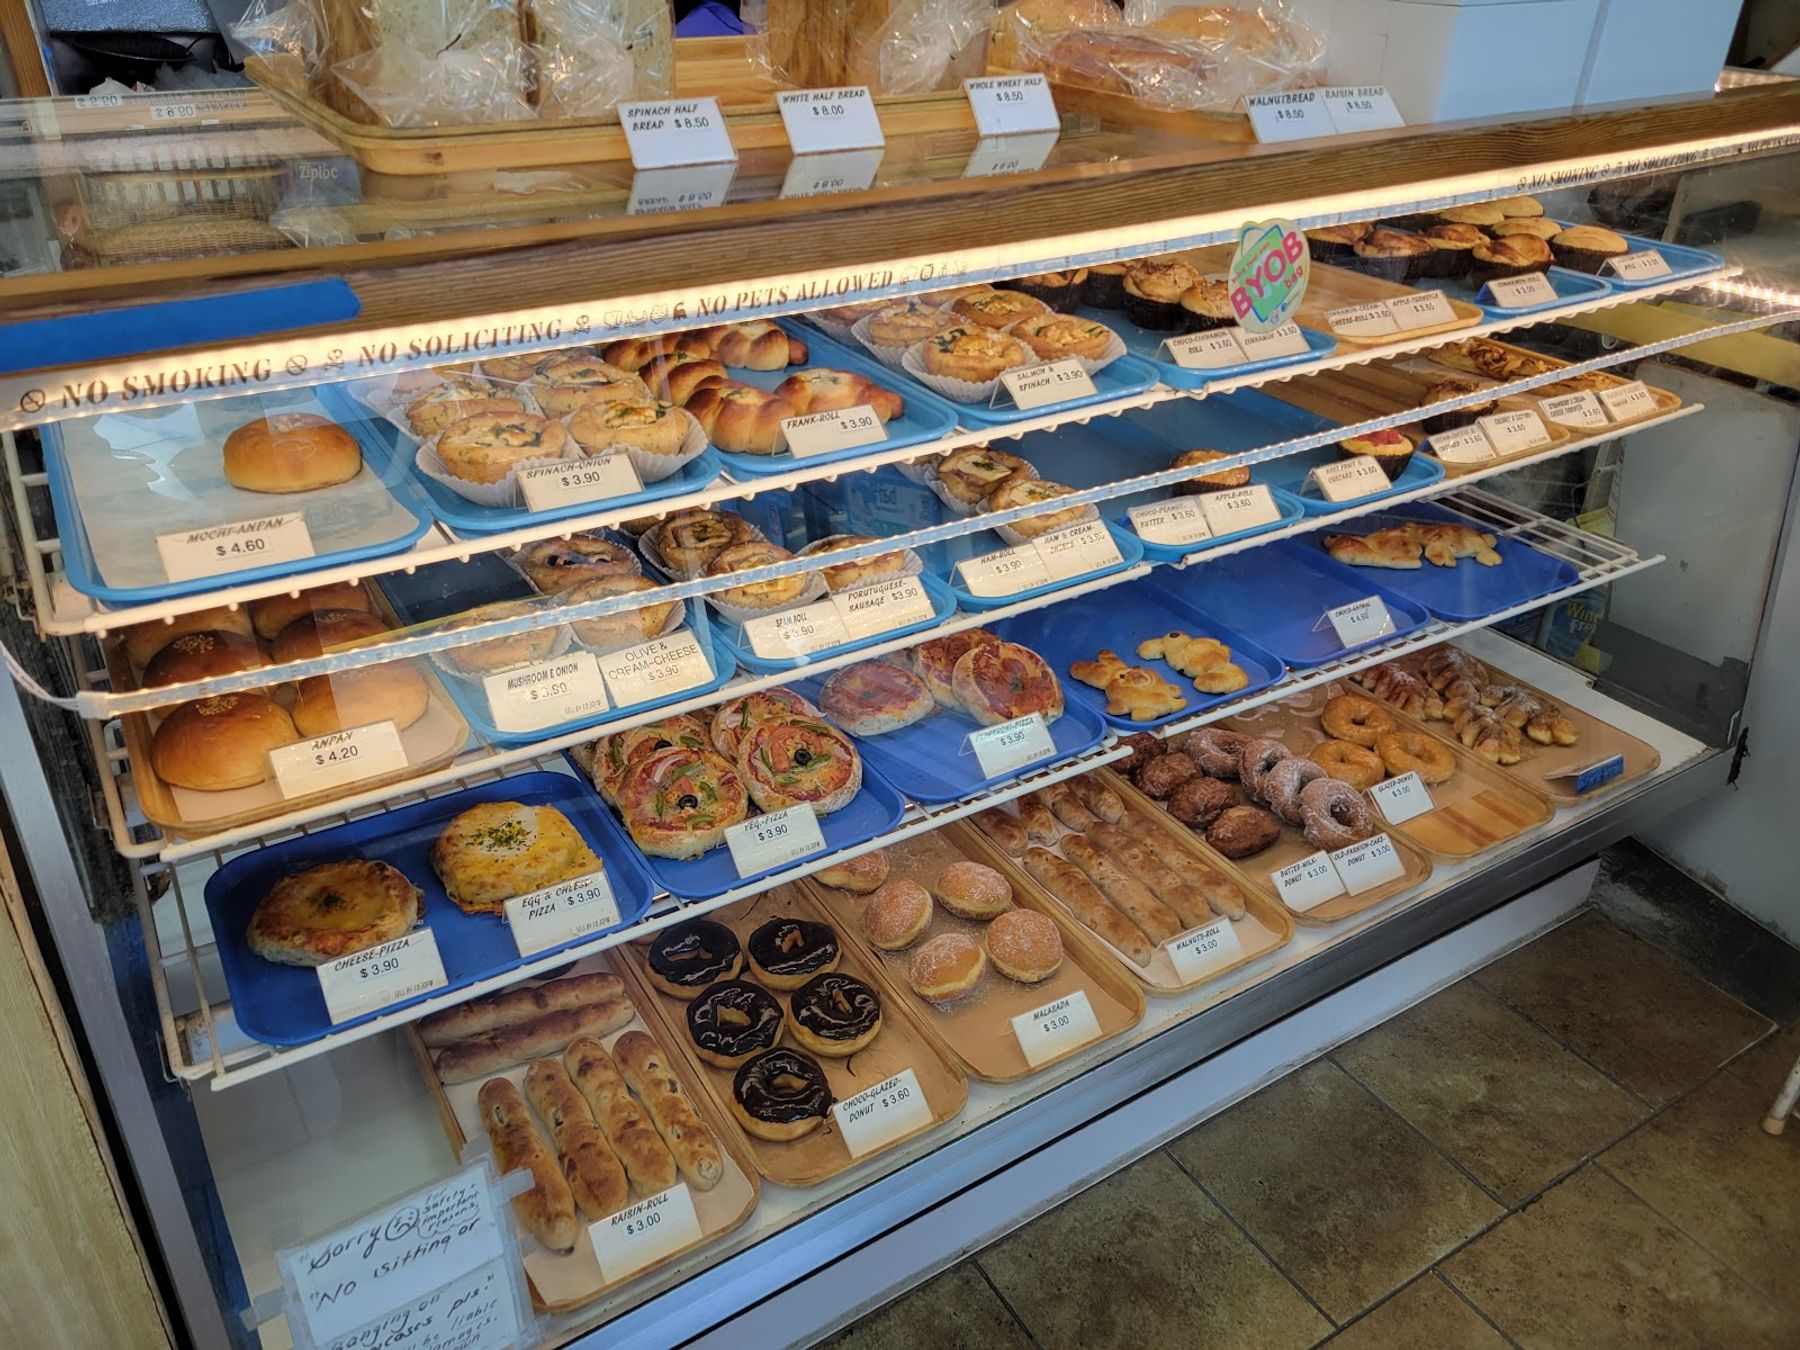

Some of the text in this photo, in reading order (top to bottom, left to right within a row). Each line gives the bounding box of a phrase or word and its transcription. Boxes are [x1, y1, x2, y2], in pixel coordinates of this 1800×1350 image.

[969, 77, 1042, 90] WHOLE WHEAT HALF
[1357, 87, 1384, 97] BREAD
[782, 89, 865, 105] WHITE HALF BREAD
[627, 103, 699, 118] SPINACH HALF
[632, 120, 664, 132] BREAD
[1231, 231, 1303, 319] BYOB
[697, 269, 894, 319] NO PETS ALLOWED
[356, 318, 564, 368] NO SOLICITING
[60, 357, 272, 409] NO SMOKING
[1018, 377, 1051, 392] SPINACH
[786, 411, 841, 429] FRANK-ROLL
[849, 416, 873, 429] 3.90
[526, 457, 612, 479] SPINACH-ONION
[572, 471, 601, 485] 3.90
[230, 538, 265, 553] 4.60
[848, 596, 885, 613] SAUSAGE
[608, 643, 699, 680] CREAM-CHEESE
[625, 643, 659, 662] OLIVE
[507, 662, 580, 691] MUSHROOM ONION
[328, 745, 359, 762] 4.20
[766, 823, 789, 840] 3.90
[521, 893, 541, 909] EGG
[528, 902, 557, 920] PIZZA
[576, 886, 601, 903] 3.90
[334, 937, 410, 972] CHEESE-PIZZA
[371, 957, 400, 976] 3.90
[849, 1102, 875, 1123] DONUT
[889, 1086, 911, 1105] 3.60
[610, 1192, 670, 1227] RAISIN-ROLL
[636, 1211, 662, 1232] 3.00
